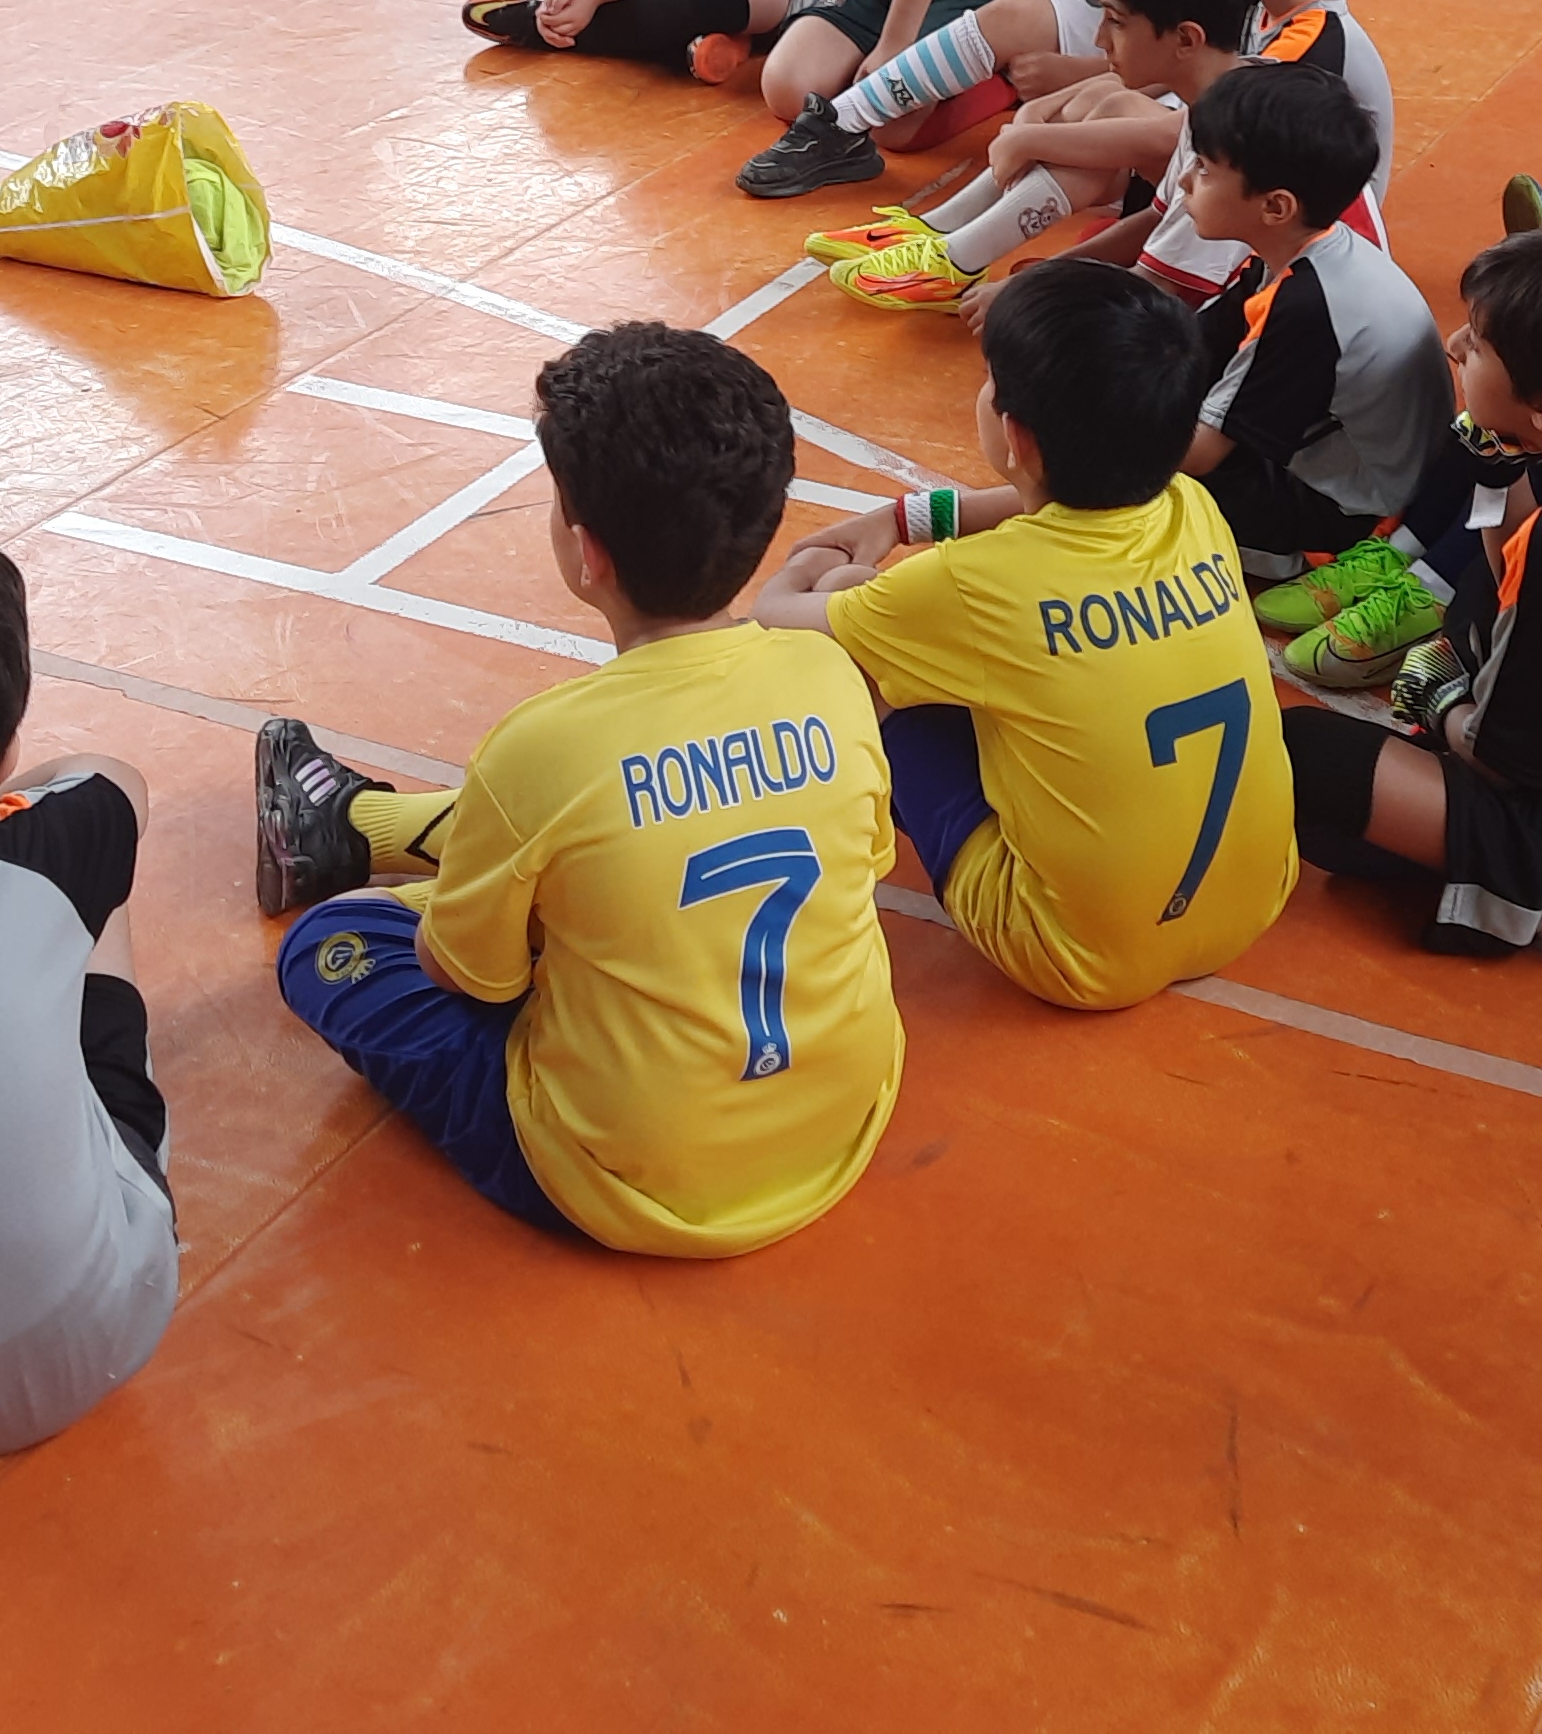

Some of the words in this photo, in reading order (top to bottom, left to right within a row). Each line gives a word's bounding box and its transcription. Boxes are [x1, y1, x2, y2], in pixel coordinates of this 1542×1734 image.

[1039, 553, 1240, 656] RONALDO
[620, 713, 838, 829] RONALDO
[1145, 677, 1252, 925] 7
[678, 827, 823, 1082] 7
